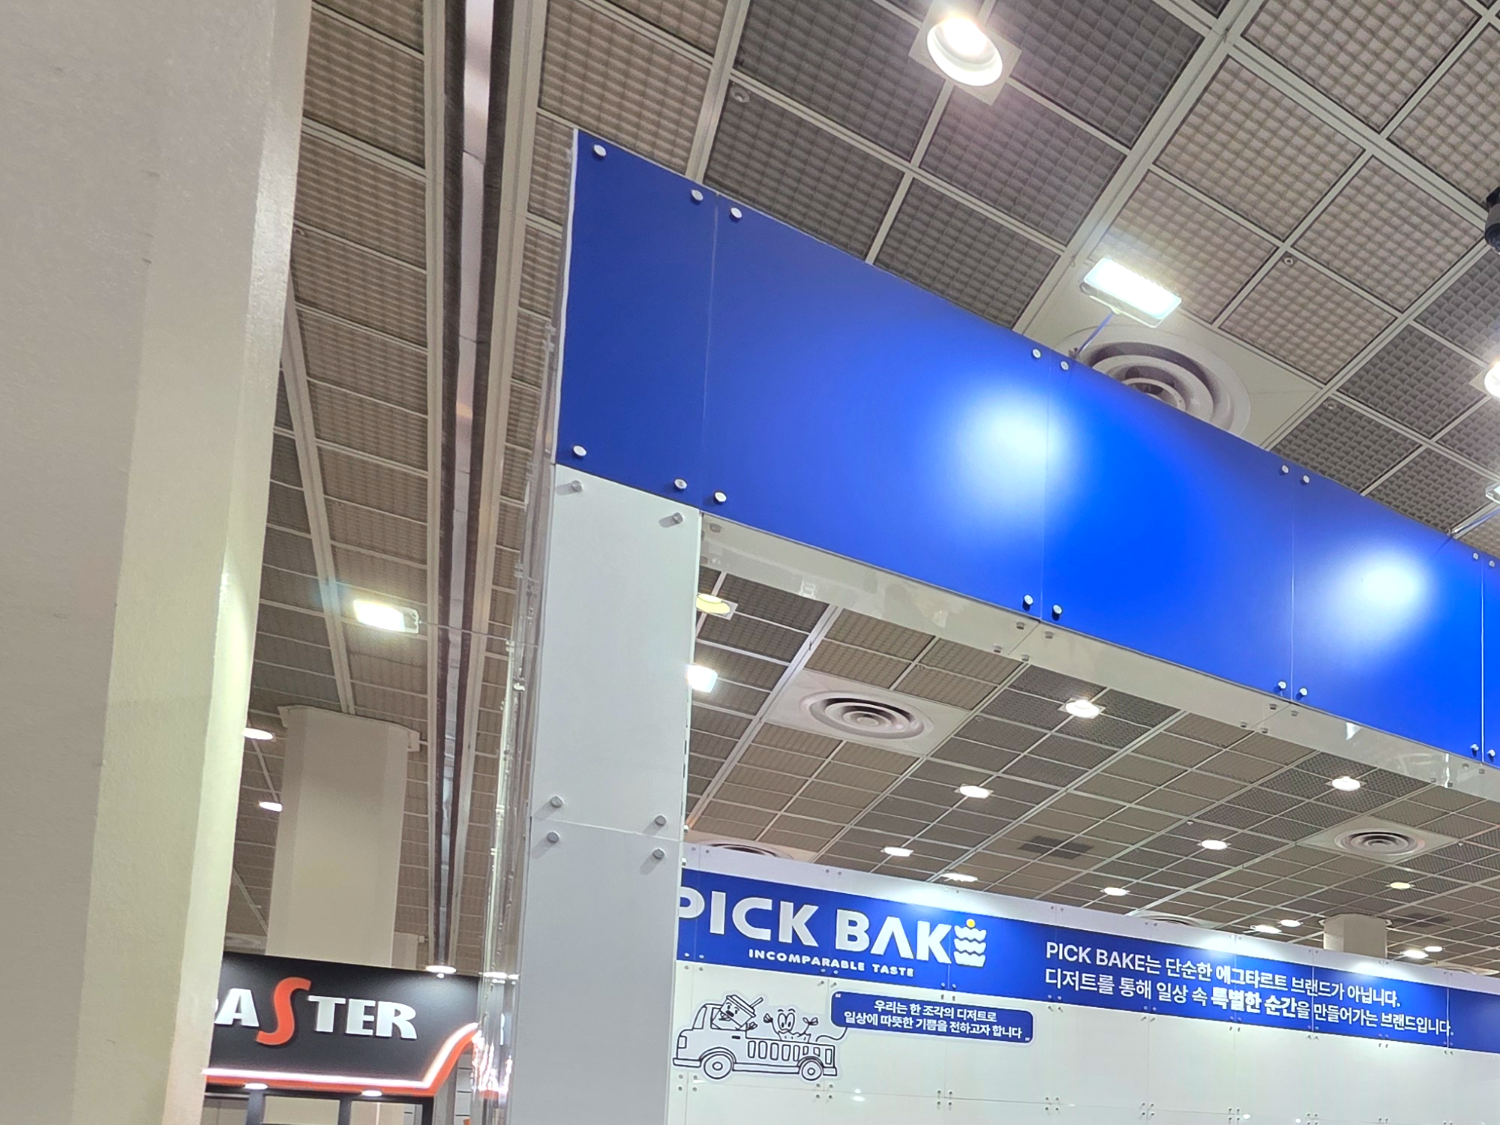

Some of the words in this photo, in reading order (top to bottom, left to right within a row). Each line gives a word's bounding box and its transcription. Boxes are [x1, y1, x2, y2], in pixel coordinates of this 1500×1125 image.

[749, 949, 865, 972] INCOMPARABLE
[872, 963, 915, 977] TASTE
[835, 909, 987, 967] BAKE
[1045, 968, 1115, 995] 디저트를
[1119, 977, 1152, 1000] 통해
[1156, 982, 1188, 1004] 일상
[1192, 986, 1208, 1006] 속
[1211, 987, 1262, 1014] 특별한
[1264, 995, 1310, 1020] 순간을
[1313, 1003, 1378, 1027] 만들어가는
[1380, 1012, 1454, 1036] 브랜드입니다.
[1046, 941, 1092, 964] PICK
[1096, 949, 1162, 975] BAKE는
[1165, 958, 1213, 982] 단순한
[1215, 965, 1288, 991] 에그타르트
[1291, 977, 1345, 1000] 브랜드가
[1347, 985, 1401, 1008] 아닙니다.
[214, 976, 418, 1046] ASTER
[844, 1011, 878, 1026] 일상에
[881, 1014, 914, 1029] 따뜻한
[916, 1017, 948, 1032] 기쁨을
[950, 1021, 991, 1036] 전하고자
[874, 1000, 908, 1015] 우리는
[910, 1003, 921, 1016] 한
[923, 1005, 954, 1020] 조각의
[957, 1008, 998, 1022] 디저트로
